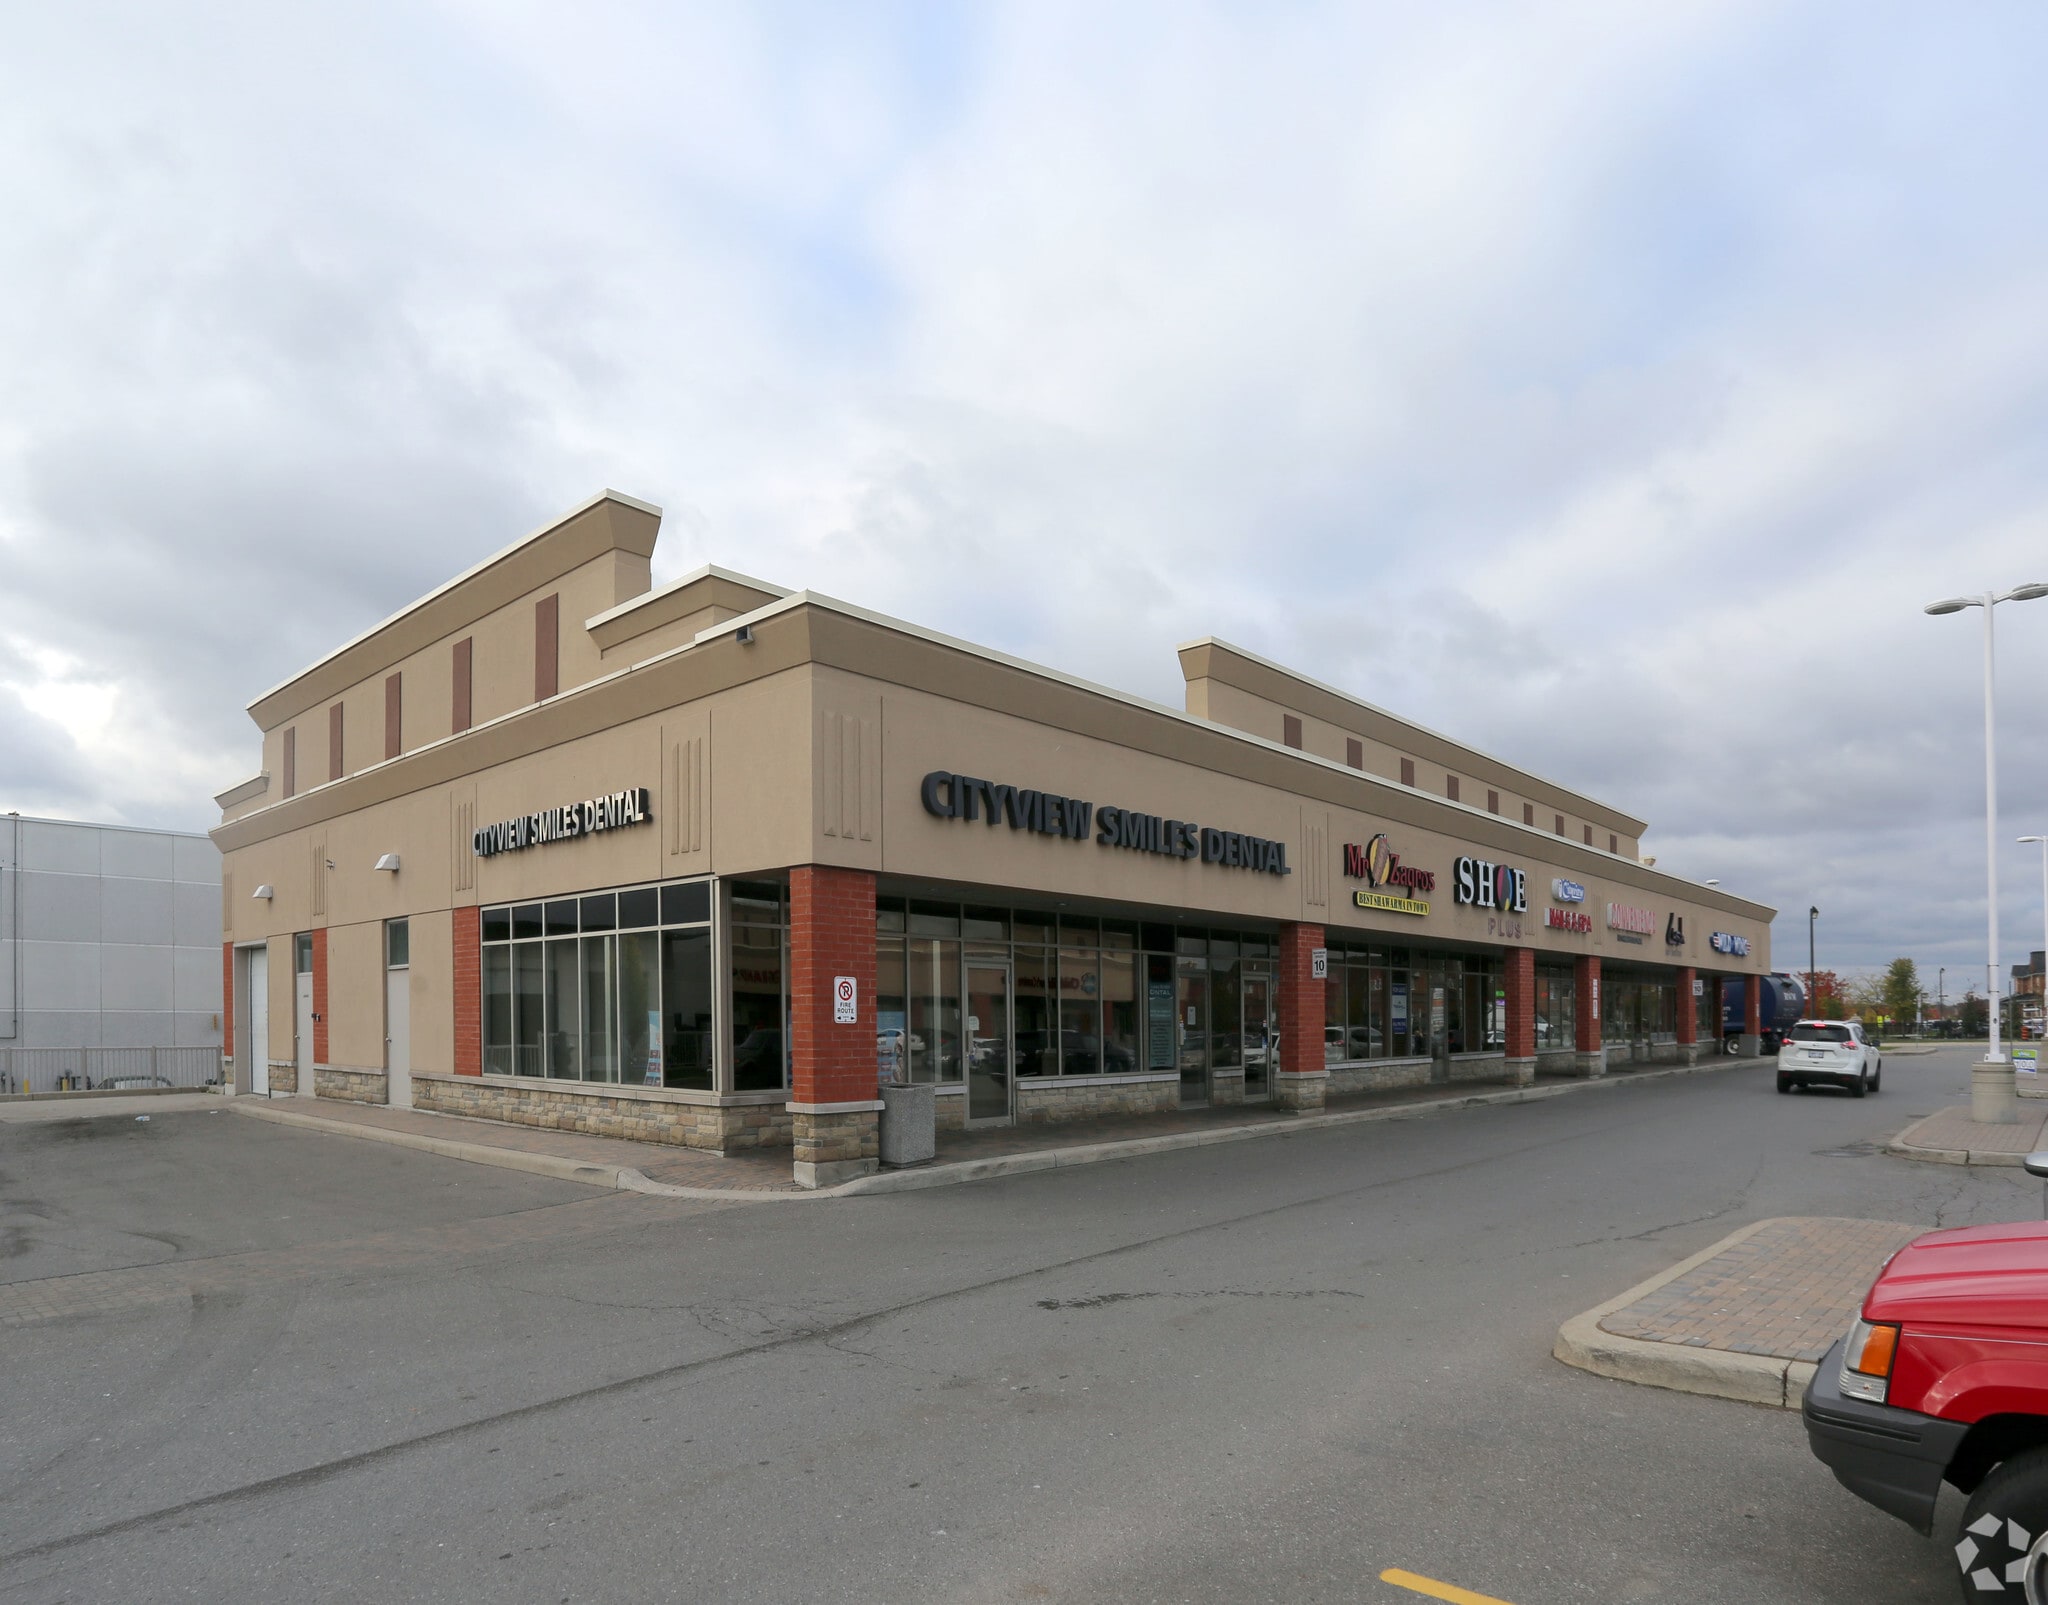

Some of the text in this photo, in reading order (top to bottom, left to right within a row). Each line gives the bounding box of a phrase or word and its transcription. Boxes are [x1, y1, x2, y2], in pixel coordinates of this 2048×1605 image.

[472, 787, 645, 857] CITYVIEW SMILES DENTAL
[921, 770, 1292, 875] CITYVIEW SMILES DENTAL
[1344, 843, 1369, 878] Mr
[1455, 856, 1528, 913] SHOE
[1359, 892, 1373, 905] BEST
[1373, 895, 1406, 910] SHAWARMA
[1413, 901, 1428, 914] TOWN
[1488, 917, 1522, 939] PLUS
[1314, 959, 1325, 972] 10
